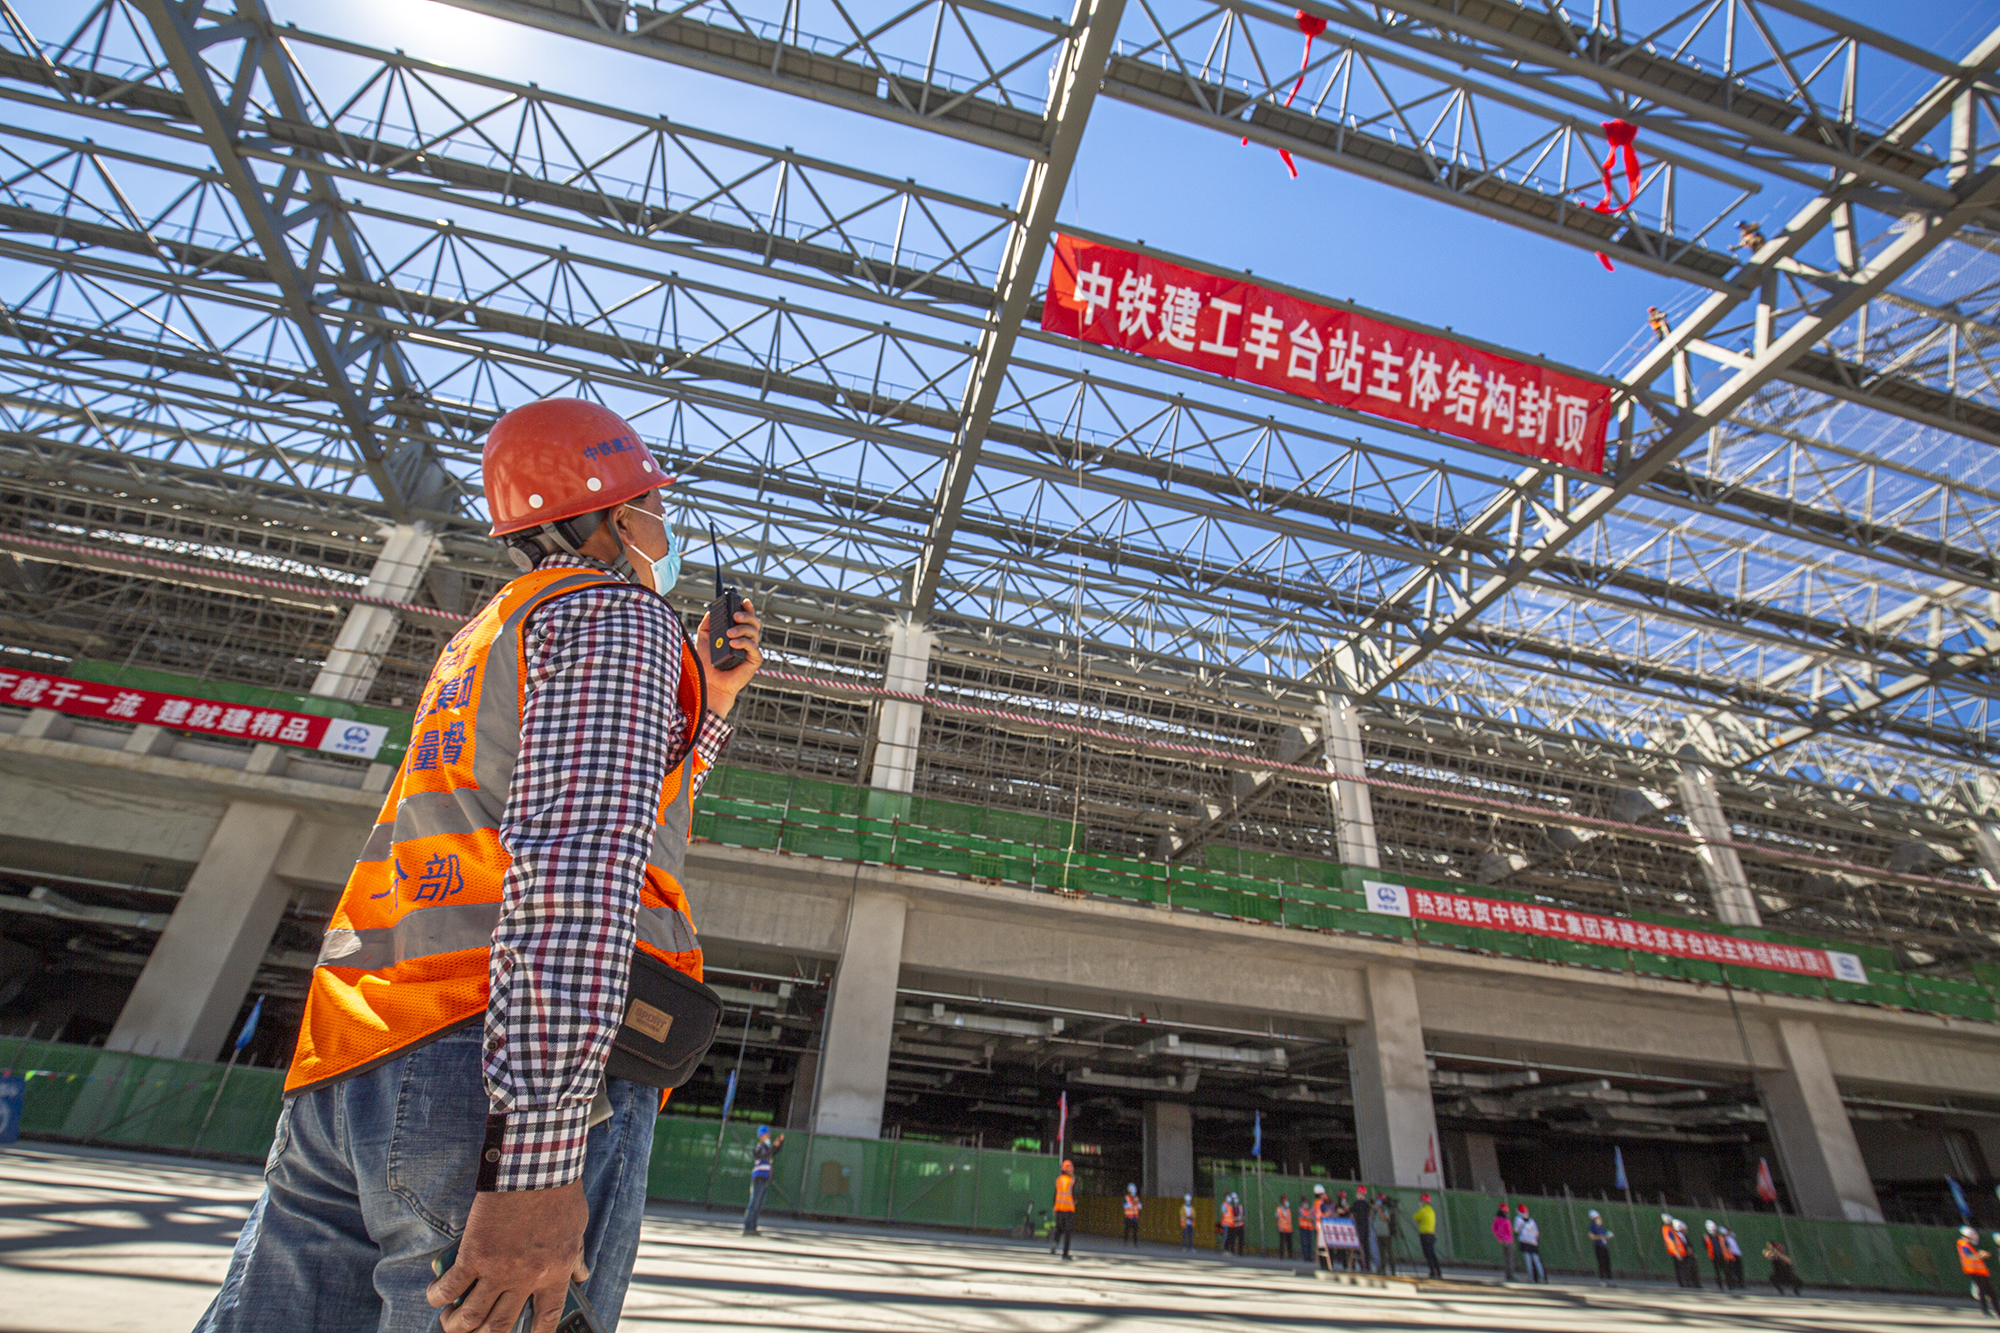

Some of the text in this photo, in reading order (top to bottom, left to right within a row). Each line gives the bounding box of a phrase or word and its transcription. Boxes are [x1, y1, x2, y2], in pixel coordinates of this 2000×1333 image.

[1074, 262, 1590, 456] 中铁建工丰台站主体结构封顶
[583, 436, 636, 461] 中铁建工
[154, 699, 310, 743] 建就建精品
